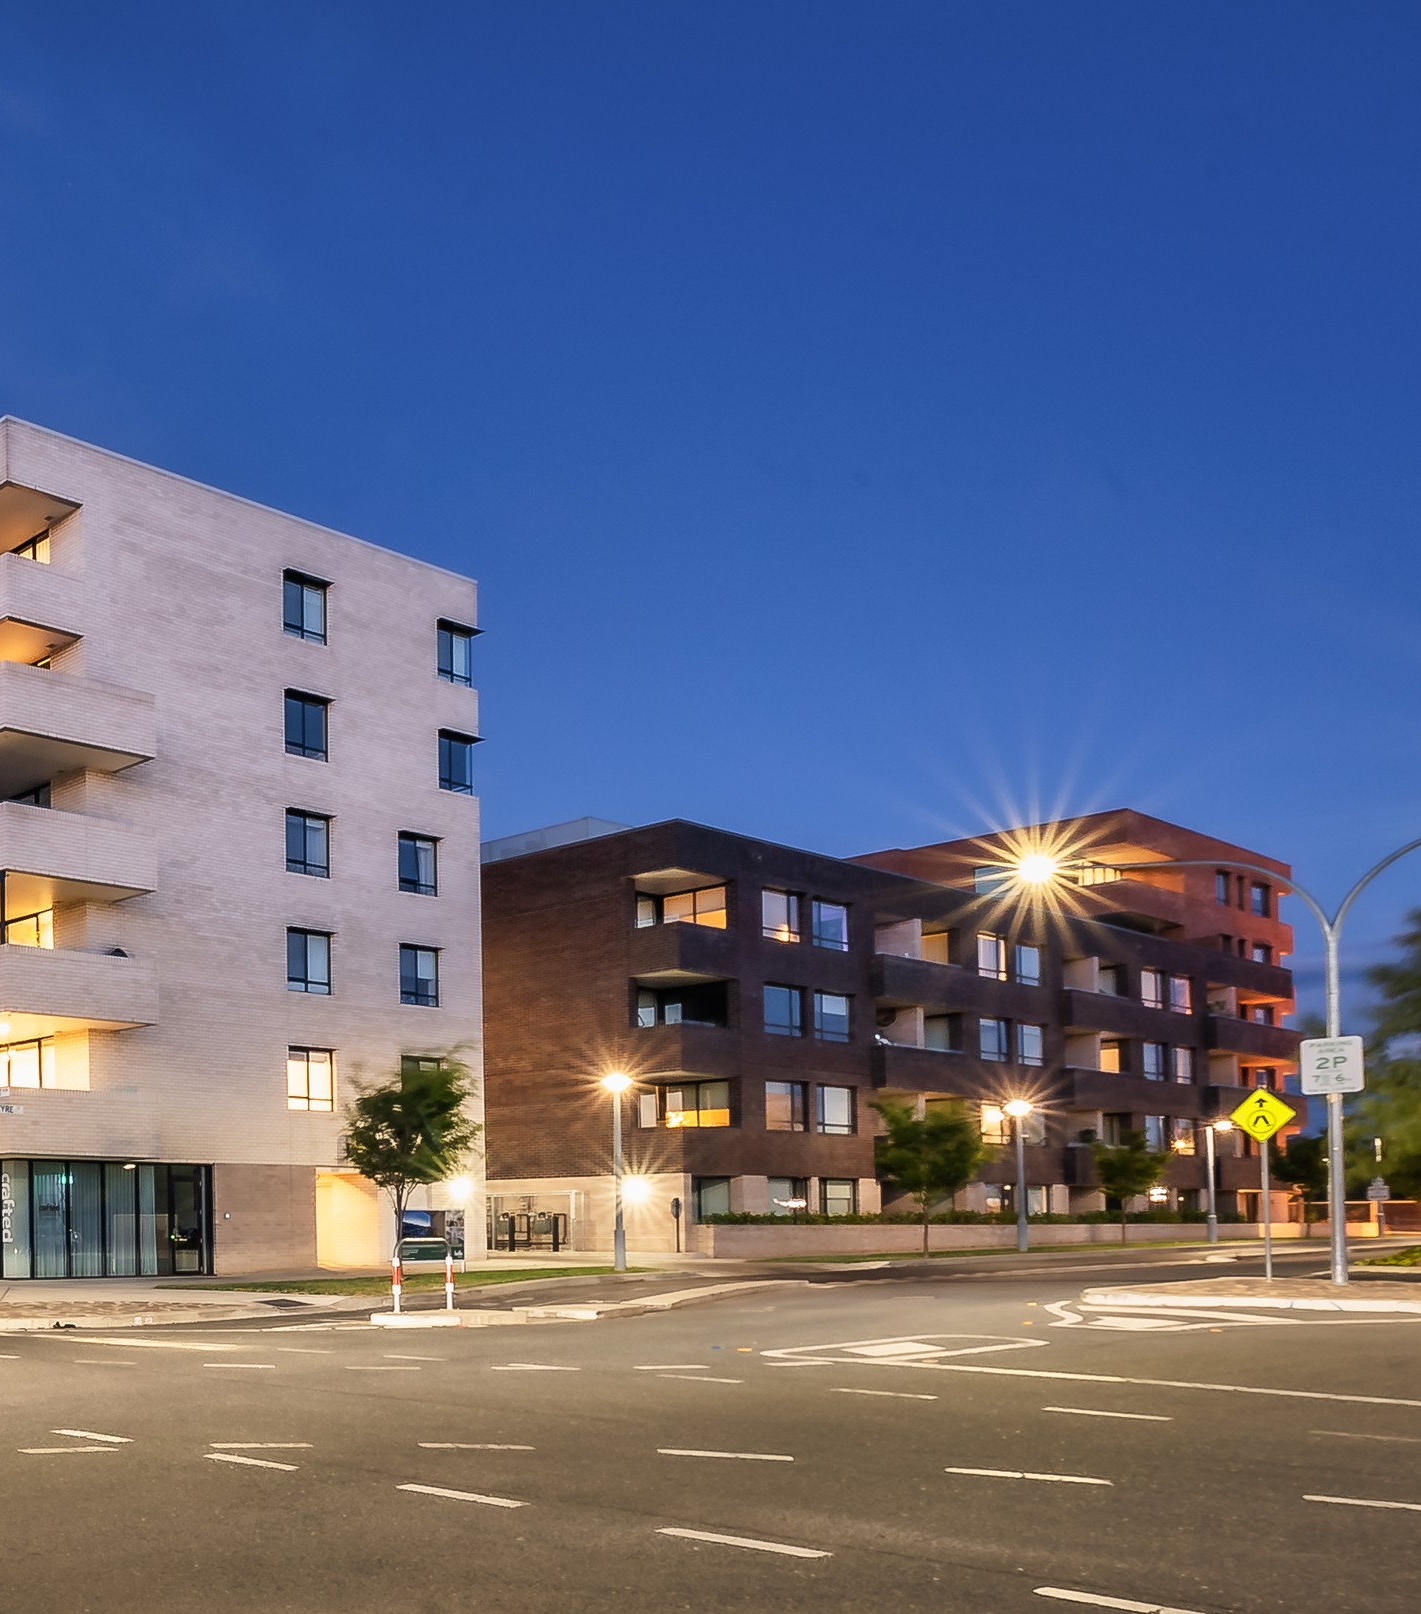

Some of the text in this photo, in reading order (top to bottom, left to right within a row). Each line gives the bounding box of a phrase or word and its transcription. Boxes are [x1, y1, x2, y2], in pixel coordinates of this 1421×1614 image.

[1315, 1055, 1348, 1070] 2P
[1335, 1073, 1346, 1082] 6
[1, 1173, 14, 1243] crafted
